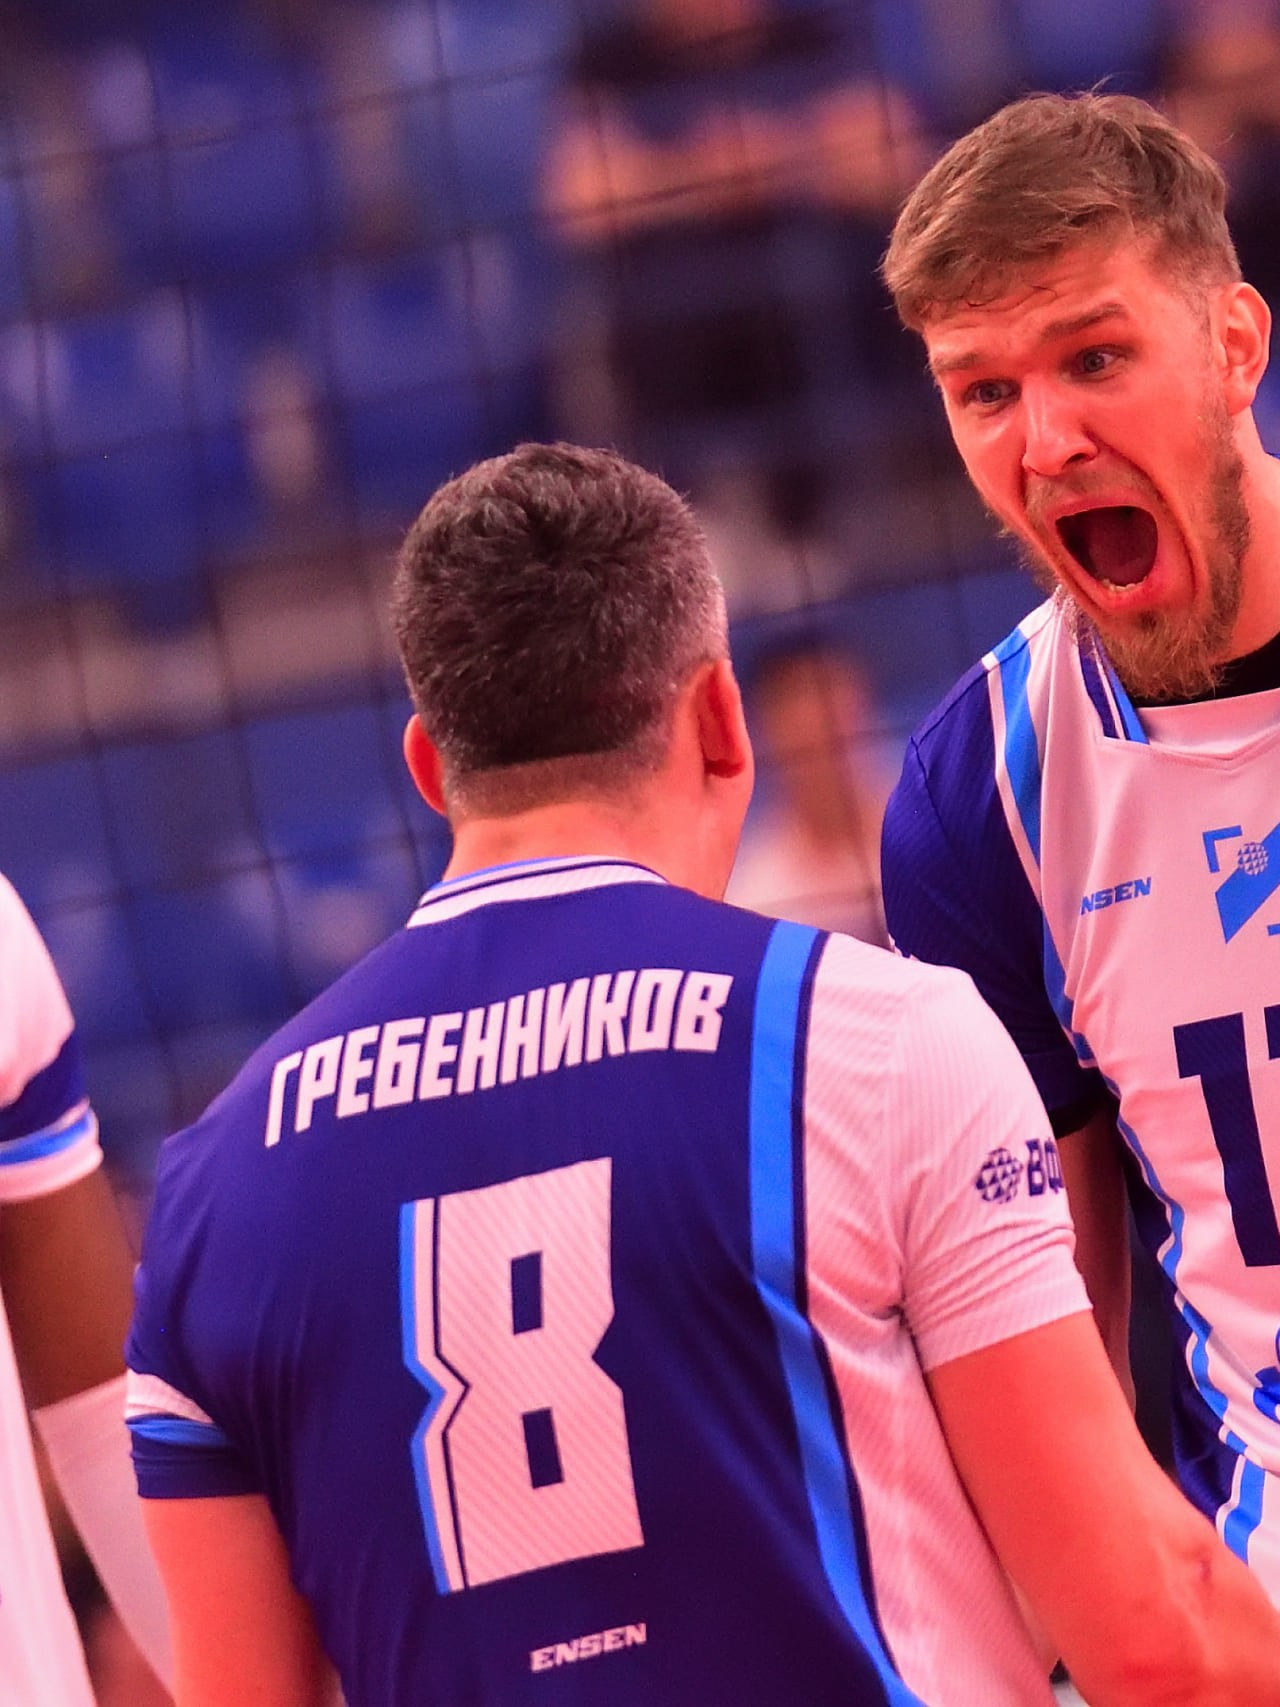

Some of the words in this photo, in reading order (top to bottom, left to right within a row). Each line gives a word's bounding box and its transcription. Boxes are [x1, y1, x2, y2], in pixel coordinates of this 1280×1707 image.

[1081, 876, 1151, 915] NSEN
[265, 968, 733, 1148] ГРЕБЕННИКОВ
[400, 1157, 645, 1595] 8
[530, 1622, 647, 1673] ENSEN
